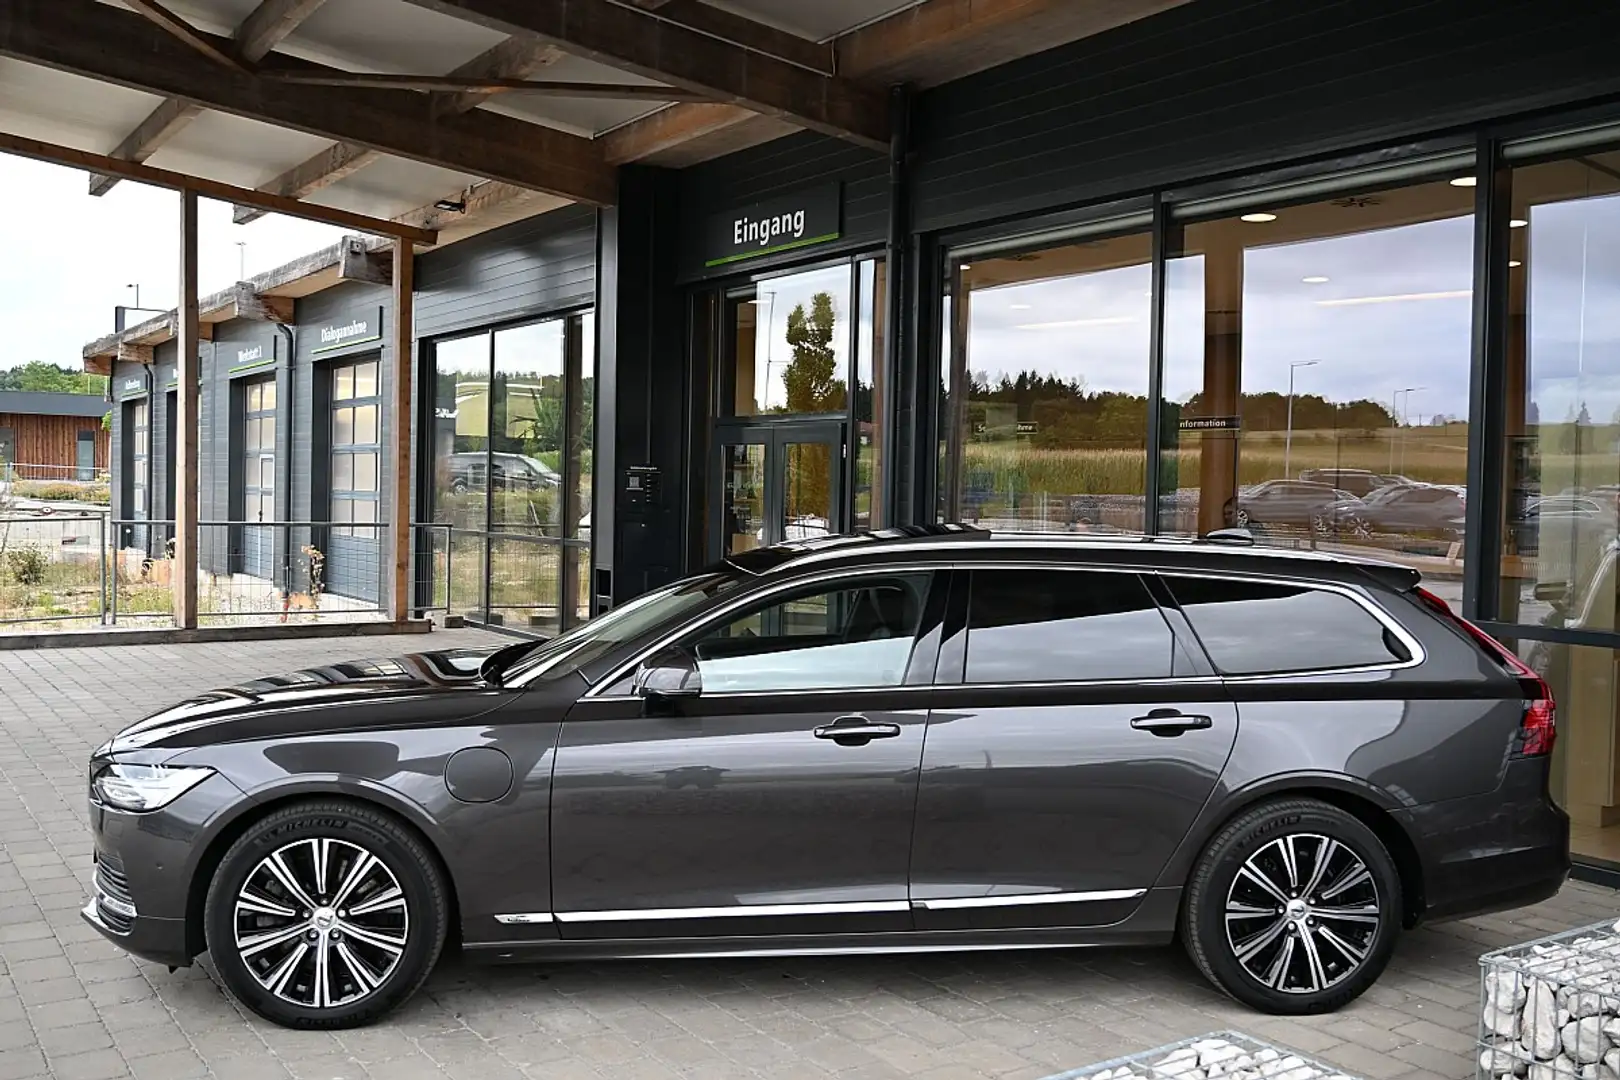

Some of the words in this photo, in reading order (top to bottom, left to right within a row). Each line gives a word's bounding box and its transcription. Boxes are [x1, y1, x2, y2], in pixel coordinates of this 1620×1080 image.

[734, 209, 805, 246] Eingang
[321, 319, 367, 344] Dialogannahme
[1179, 418, 1226, 428] nformation
